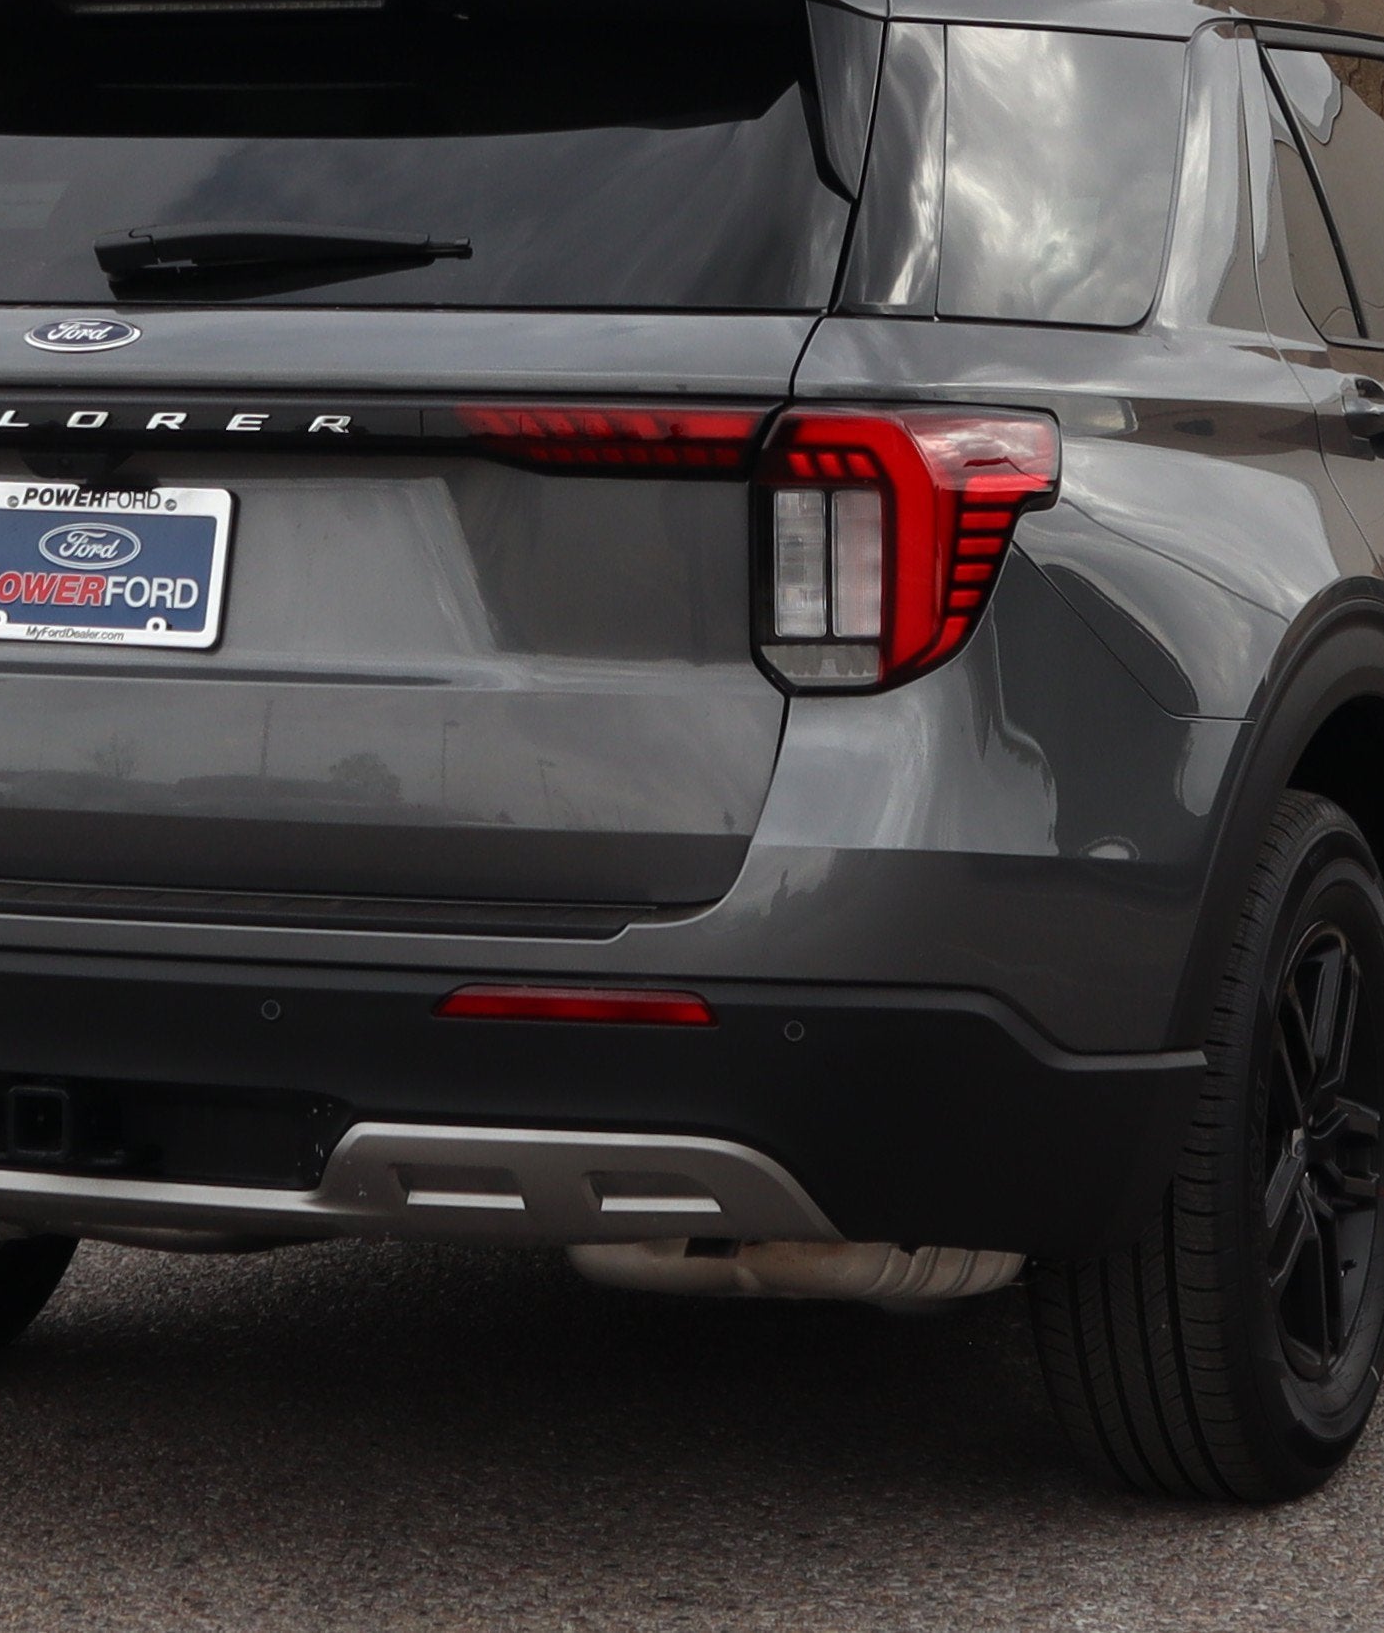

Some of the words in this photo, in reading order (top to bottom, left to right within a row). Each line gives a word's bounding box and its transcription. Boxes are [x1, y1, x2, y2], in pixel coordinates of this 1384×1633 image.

[47, 321, 112, 344] Ford
[22, 487, 161, 510] POWERFORD
[58, 528, 120, 560] Ford
[25, 626, 125, 642] MyFordDealer.com
